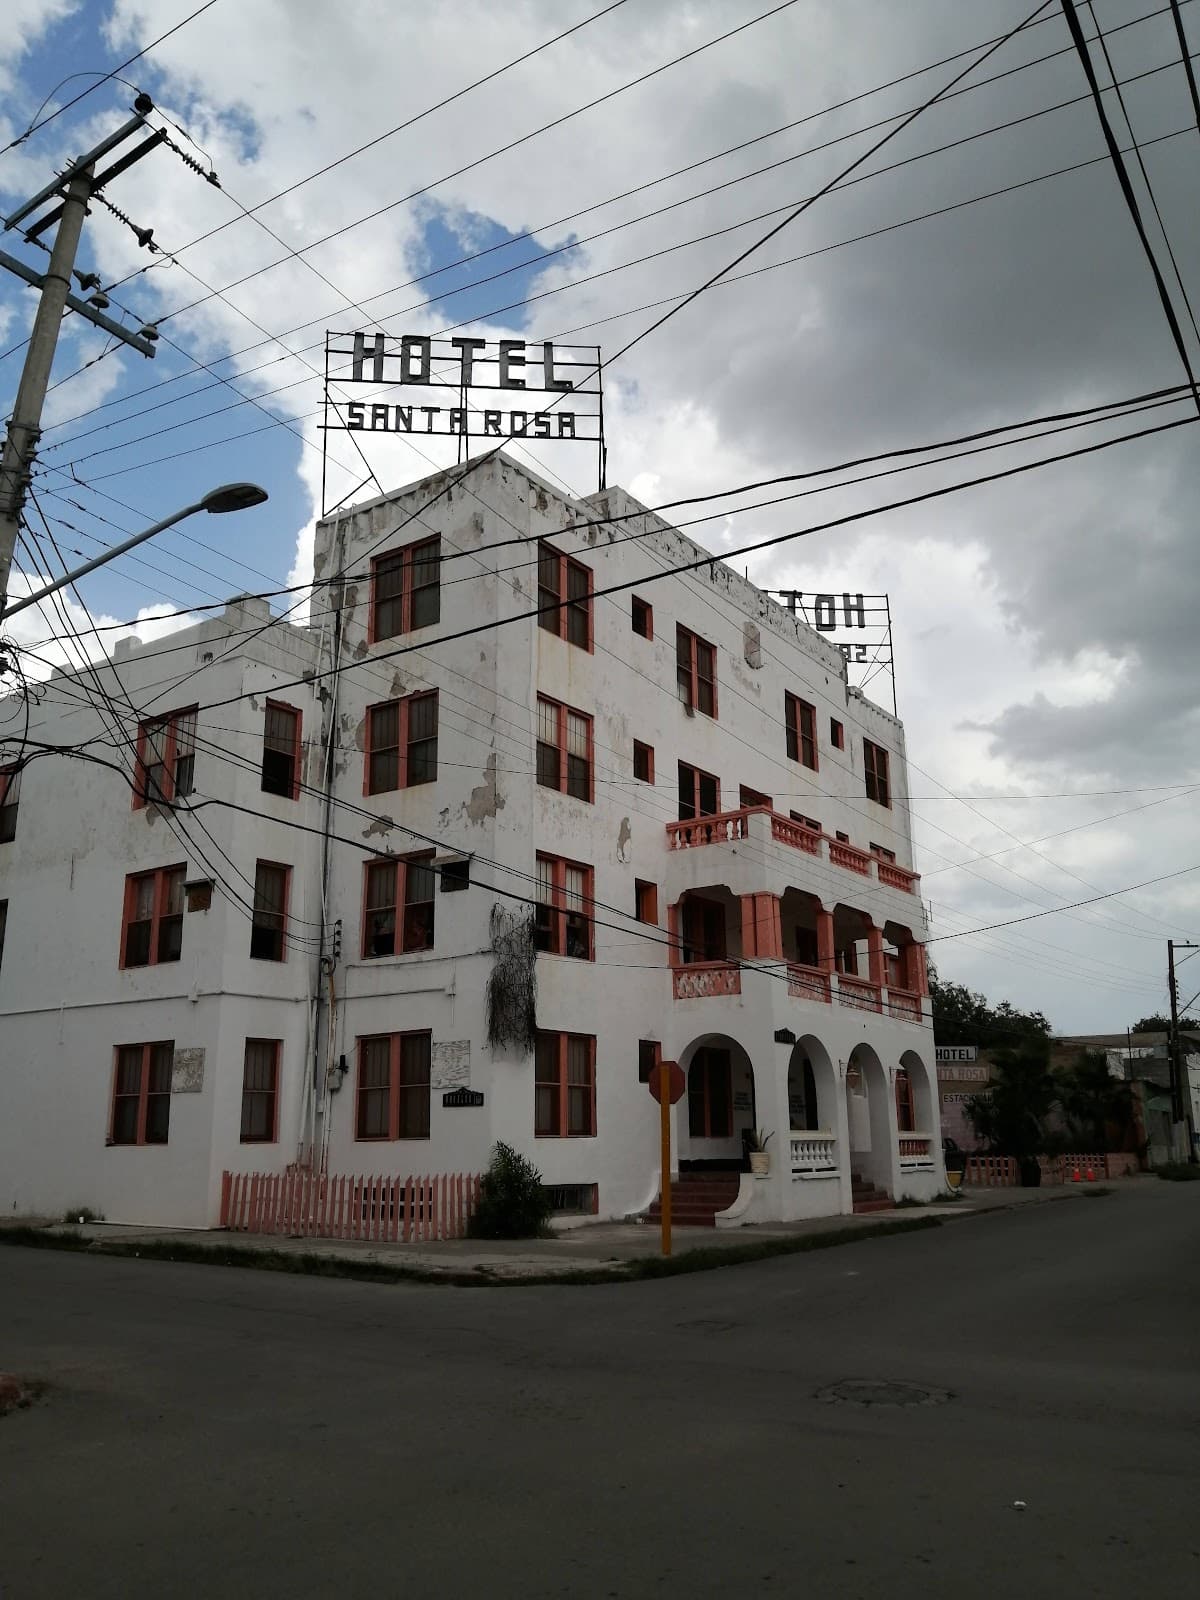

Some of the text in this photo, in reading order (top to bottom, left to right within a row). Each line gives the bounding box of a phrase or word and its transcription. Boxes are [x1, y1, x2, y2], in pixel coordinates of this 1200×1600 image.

[352, 332, 573, 390] HOTEL
[348, 402, 575, 438] SANTA ROSA
[936, 1049, 973, 1060] HOTEL
[958, 1068, 985, 1081] ROSA
